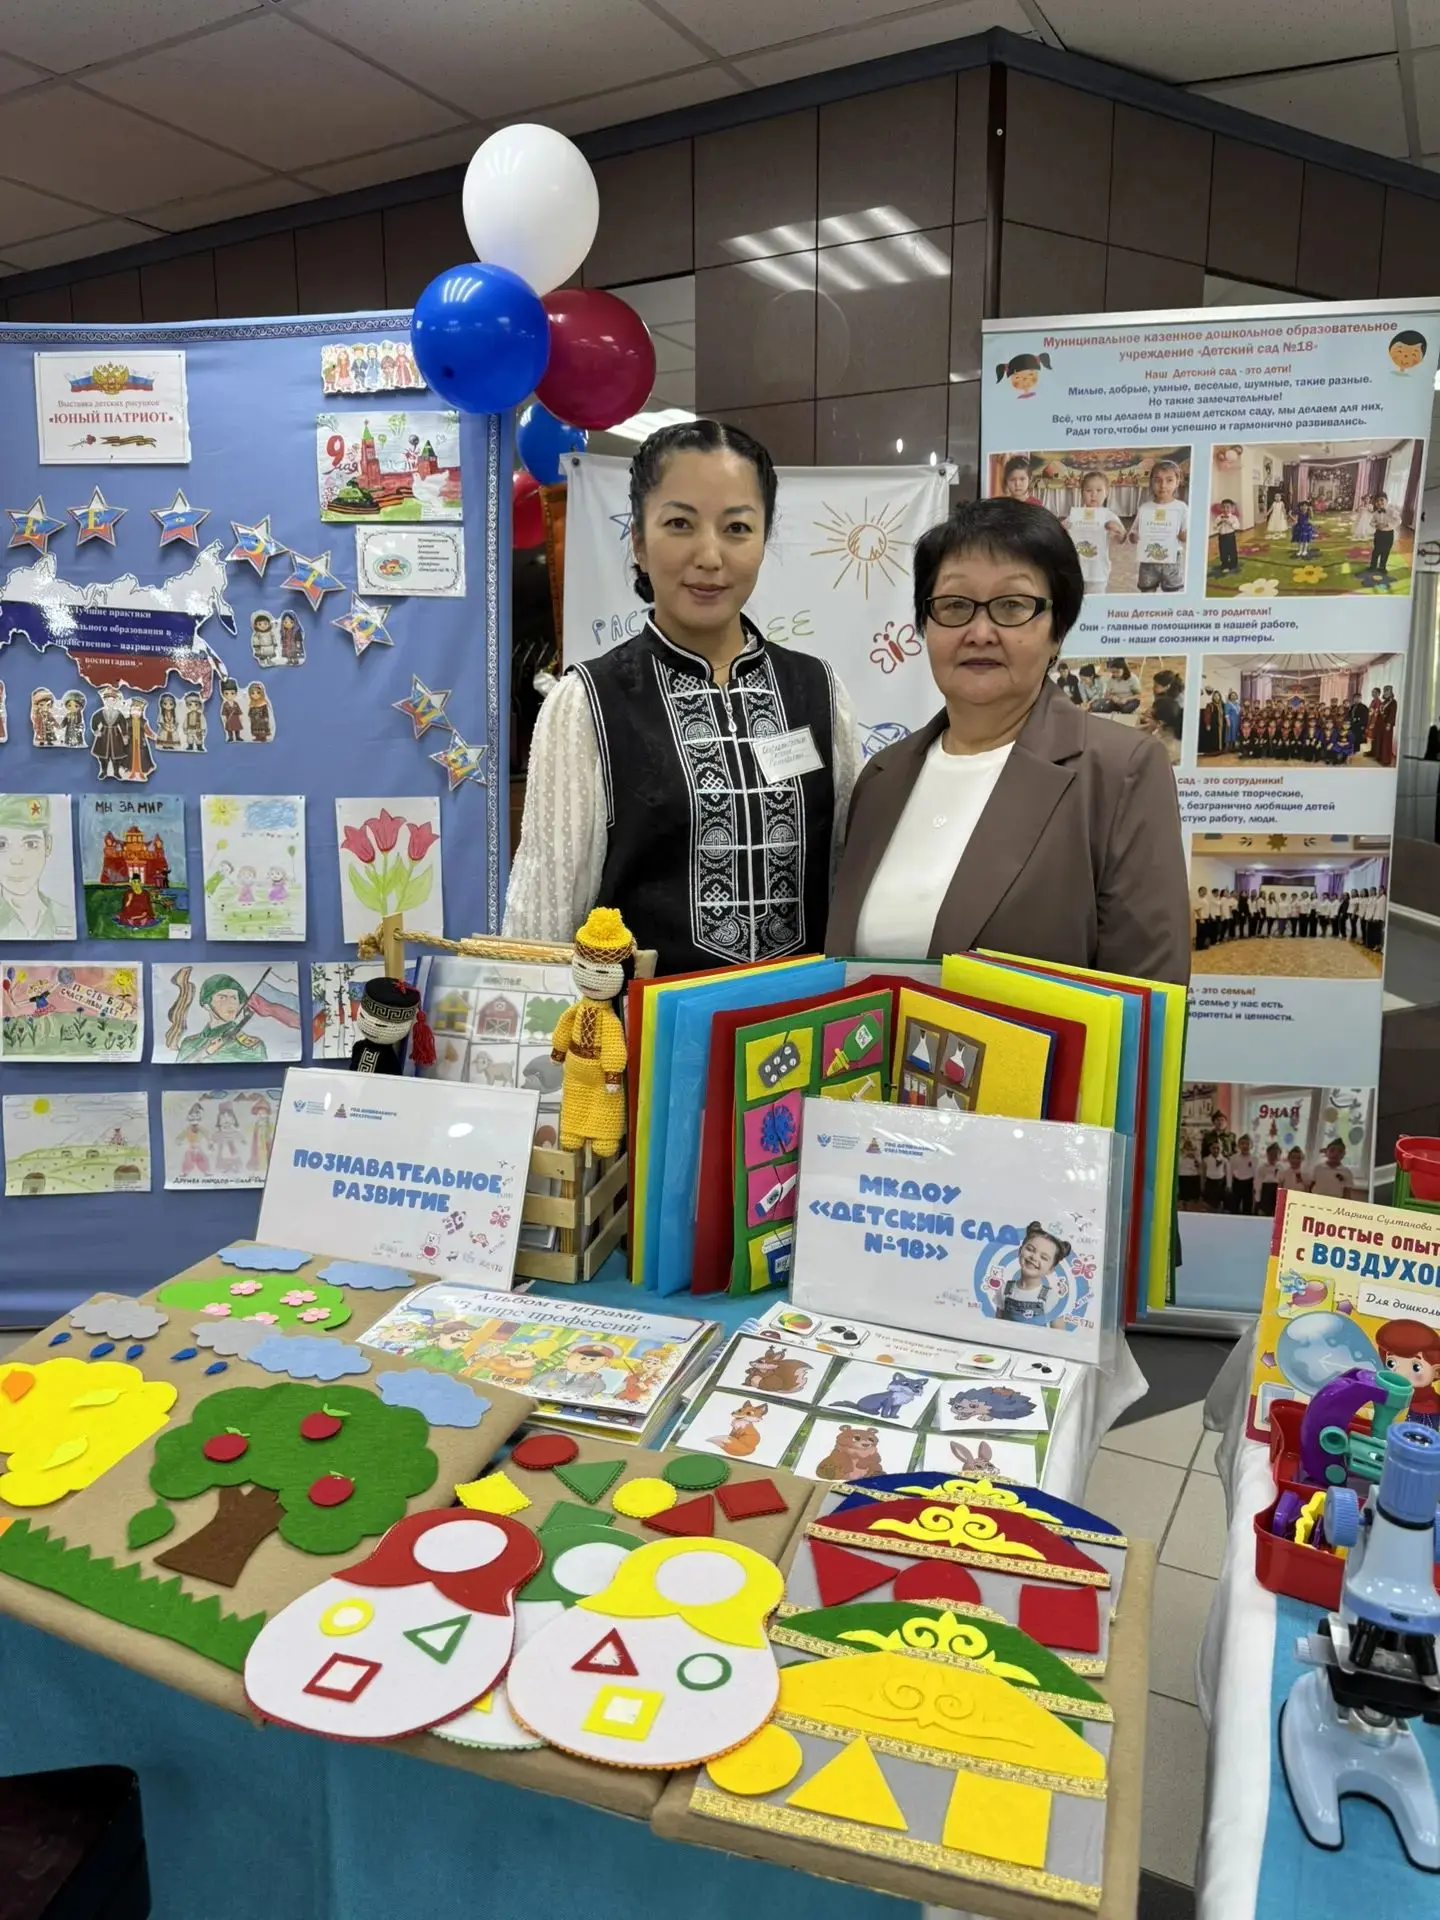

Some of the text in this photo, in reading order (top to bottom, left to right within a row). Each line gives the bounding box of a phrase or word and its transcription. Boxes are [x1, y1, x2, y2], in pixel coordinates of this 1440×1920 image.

[1043, 321, 1398, 350] Муниципальное казенное дошкольное образовательное
[1119, 347, 1195, 363] учреждение
[1257, 344, 1280, 354] сад
[1145, 370, 1168, 379] Наш
[1172, 367, 1217, 379] Детский
[1219, 367, 1237, 377] сад
[1245, 367, 1263, 375] это
[1264, 364, 1292, 375] дети!
[1068, 386, 1107, 396] Милые,
[1108, 384, 1151, 395] добрые,
[1153, 383, 1191, 395] умные,
[1244, 379, 1292, 391] шумные,
[1295, 377, 1326, 387] такие
[1328, 376, 1373, 387] разные.
[58, 400, 161, 409] Выставка детских рисунков
[1148, 391, 1283, 407] Но такие замечательные!
[48, 410, 174, 424] «ЮНЫЙ ПАТРИОТ»
[1076, 414, 1093, 423] что
[1095, 413, 1112, 422] мы
[1114, 411, 1152, 422] делаем
[1154, 412, 1161, 420] в
[1164, 409, 1200, 419] нашем
[1203, 407, 1247, 418] детском
[1248, 407, 1276, 418] саду,
[1278, 406, 1295, 415] мы
[1297, 405, 1337, 415] делаем
[1339, 404, 1359, 414] для
[1361, 403, 1384, 413] них,
[1066, 426, 1091, 437] Ради
[1150, 425, 1169, 434] они
[1171, 423, 1217, 435] успешно
[1219, 423, 1227, 431] и
[1229, 419, 1293, 432] гармонично
[1295, 417, 1367, 430] развивались.
[326, 434, 345, 466] 9
[322, 461, 359, 475] мая
[108, 609, 151, 619] практики
[1107, 609, 1130, 619] Наш
[1131, 607, 1173, 618] Детский
[1176, 608, 1195, 617] сад
[1202, 608, 1219, 617] это
[1221, 606, 1272, 618] родители!
[109, 624, 164, 636] образования
[1079, 623, 1099, 632] Они
[1106, 622, 1149, 632] главные
[1151, 621, 1212, 632] помощники
[1214, 621, 1221, 629] в
[1223, 619, 1258, 629] нашей
[1260, 619, 1299, 630] работе,
[1100, 635, 1120, 644] Они
[1128, 635, 1157, 644] наши
[1158, 634, 1210, 644] союзники
[1212, 635, 1219, 643] и
[1221, 633, 1275, 644] партнеры.
[1177, 776, 1196, 785] сад
[1203, 776, 1220, 785] это
[1222, 775, 1284, 788] сотрудники!
[1204, 789, 1239, 798] самые
[1242, 789, 1304, 799] творческие,
[95, 801, 164, 815] МЫ ЗА МИР
[1186, 801, 1336, 812] безгранично любящие детей
[1181, 814, 1279, 825] стую работу, люди.
[1201, 987, 1219, 995] это
[1220, 987, 1256, 996] семья!
[1198, 999, 1230, 1007] семье
[1231, 1001, 1239, 1009] у
[1240, 1001, 1259, 1009] нас
[1261, 1001, 1284, 1009] есть
[1188, 1011, 1233, 1020] оритеты
[1244, 1012, 1295, 1022] ценности.
[293, 1148, 503, 1195] ПОЗНАВАТЕЛЬНОЕ
[332, 1179, 451, 1213] РАЗВИТИЕ
[860, 1173, 962, 1205] МКДОУ
[1332, 1207, 1433, 1232] Марина Султанова
[960, 1217, 1021, 1246] САД
[1302, 1215, 1385, 1247] Простые
[1296, 1247, 1306, 1261] с
[472, 1291, 645, 1322] Альбом с играми
[1365, 1292, 1389, 1307] Для
[474, 1304, 524, 1318] мире
[527, 1309, 652, 1335] профессий"
